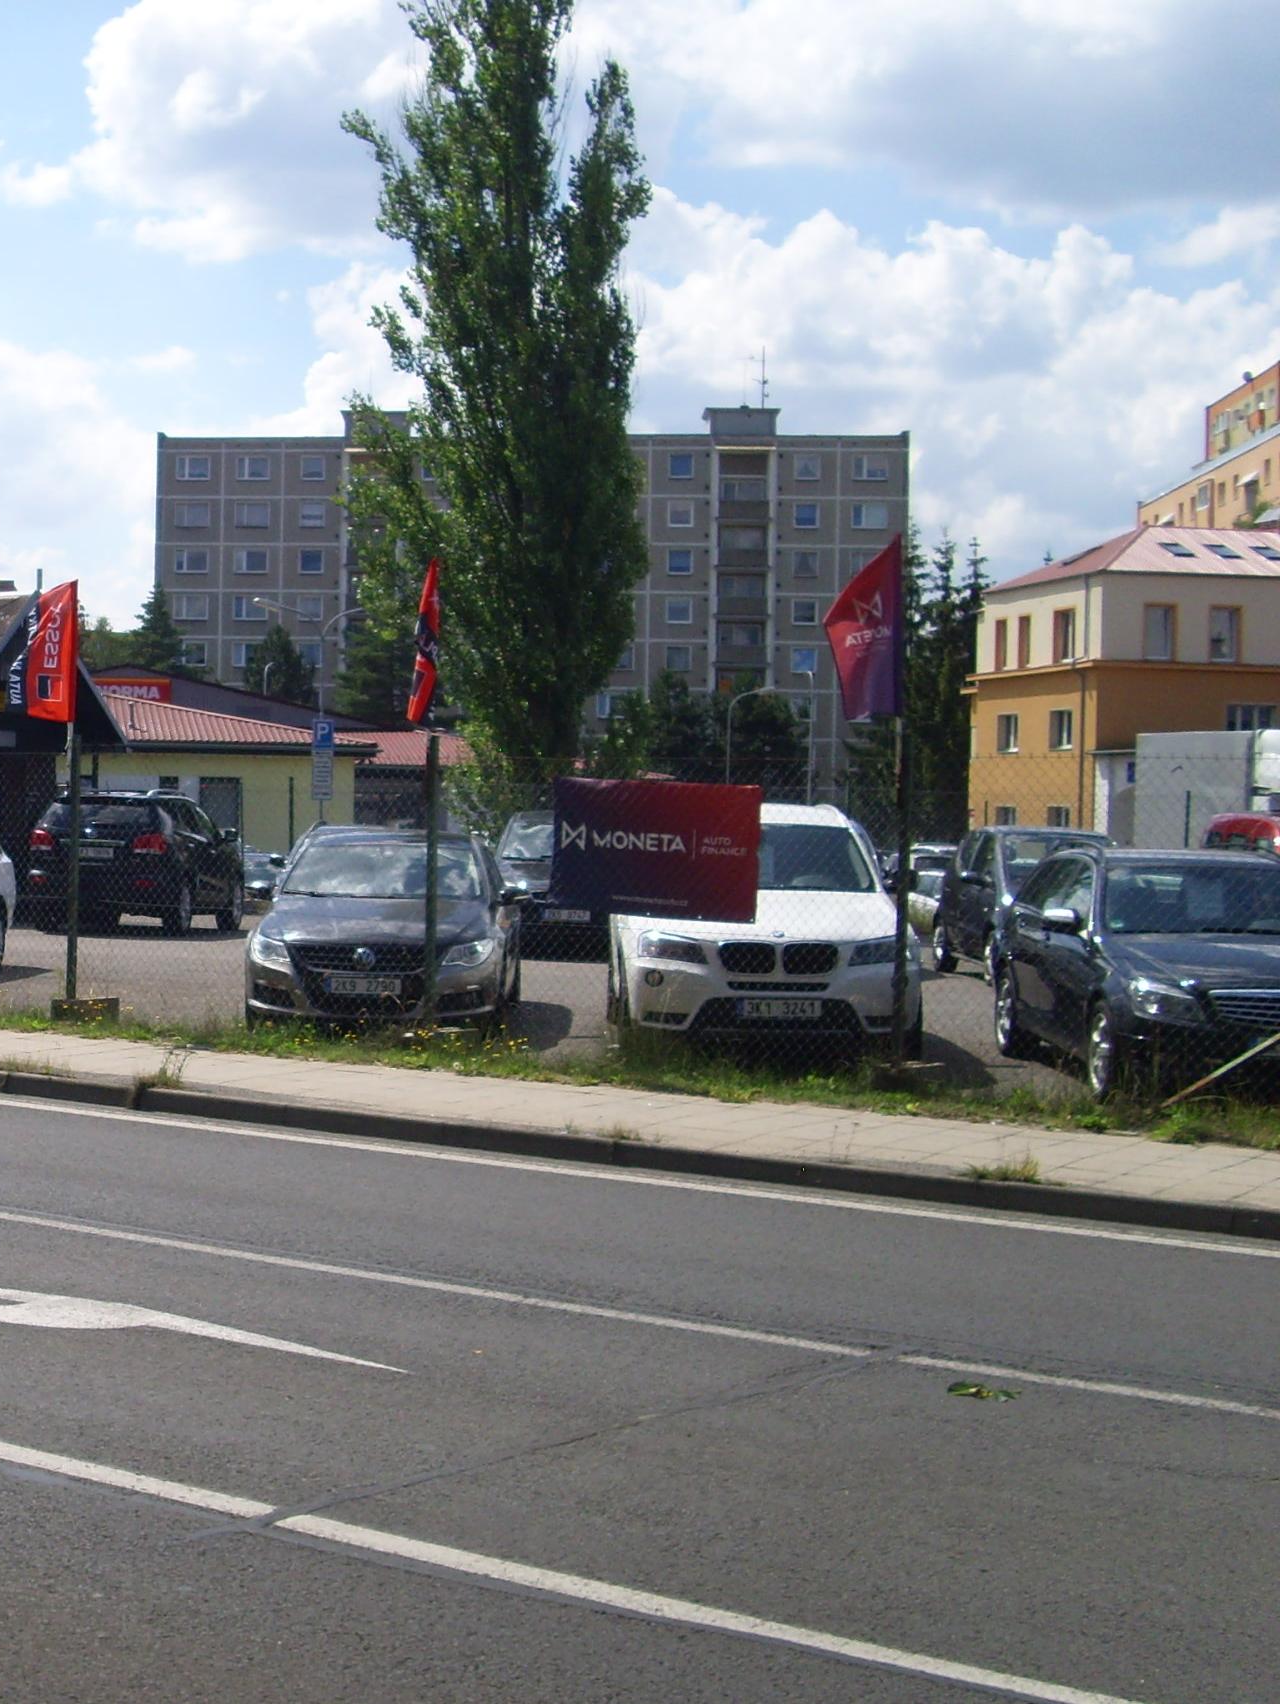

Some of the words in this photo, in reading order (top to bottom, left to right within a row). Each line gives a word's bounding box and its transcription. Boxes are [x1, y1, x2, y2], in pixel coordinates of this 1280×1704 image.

[316, 723, 329, 741] P
[592, 829, 687, 853] MONETA
[702, 836, 732, 846] AUTO
[782, 1001, 817, 1016] 3241
